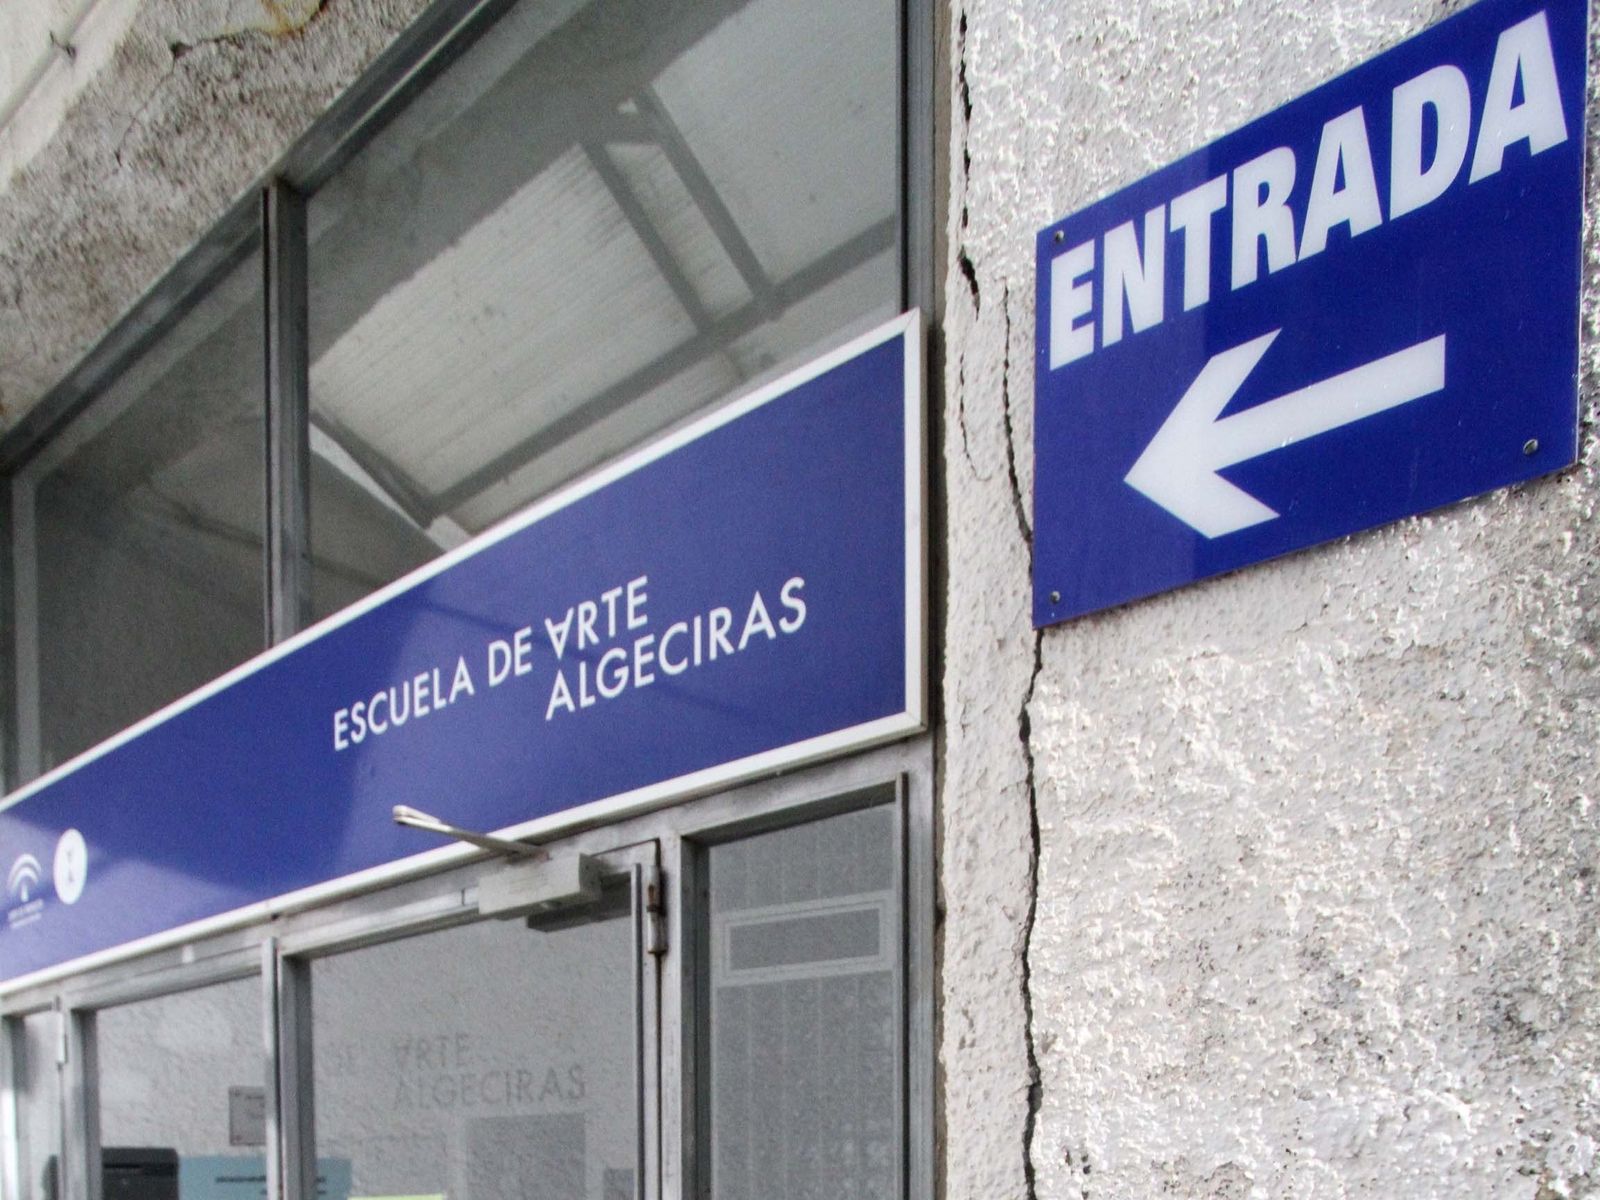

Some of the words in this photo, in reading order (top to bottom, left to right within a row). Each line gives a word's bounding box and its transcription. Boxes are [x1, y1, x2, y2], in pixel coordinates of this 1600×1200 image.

[1050, 10, 1568, 371] ENTRADA
[333, 656, 475, 751] ESCUELA
[487, 626, 533, 688] DE
[545, 576, 807, 720] ALGECIRAS
[391, 1063, 586, 1111] ALGECIRAS
